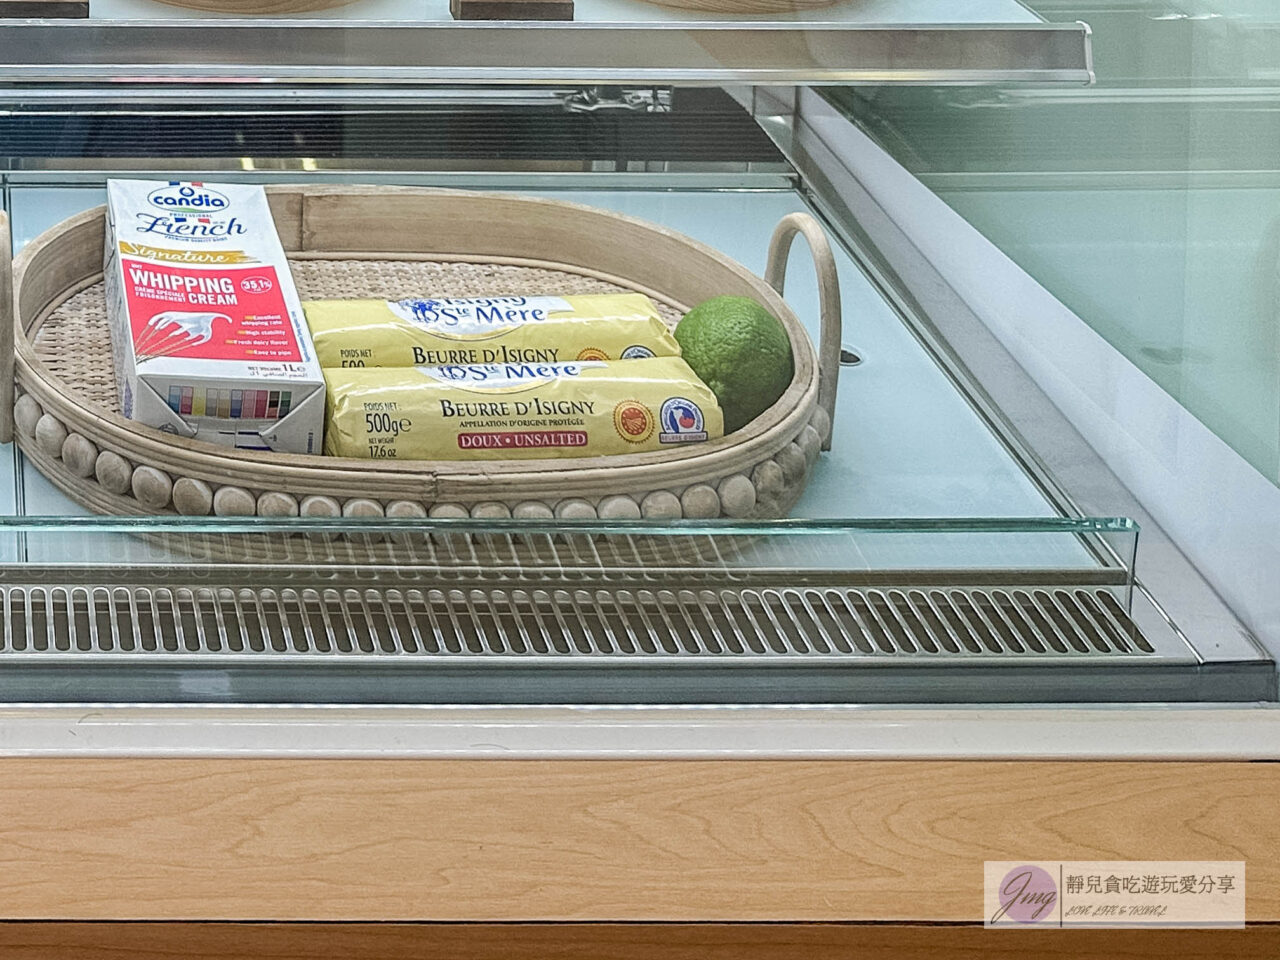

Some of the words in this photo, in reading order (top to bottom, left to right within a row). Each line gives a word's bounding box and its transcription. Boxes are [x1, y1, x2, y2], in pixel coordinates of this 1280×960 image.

[153, 193, 225, 208] candia
[136, 212, 248, 237] French
[126, 241, 231, 263] Signature
[128, 268, 235, 294] WHIPPING
[188, 292, 238, 305] CREAM
[476, 306, 545, 324] Mère
[439, 399, 510, 418] BEURRE
[459, 420, 507, 428] APPELLATION
[461, 435, 503, 448] DOUX
[514, 433, 586, 447] UNSALTED
[369, 445, 387, 458] 17.6
[387, 448, 397, 457] oz
